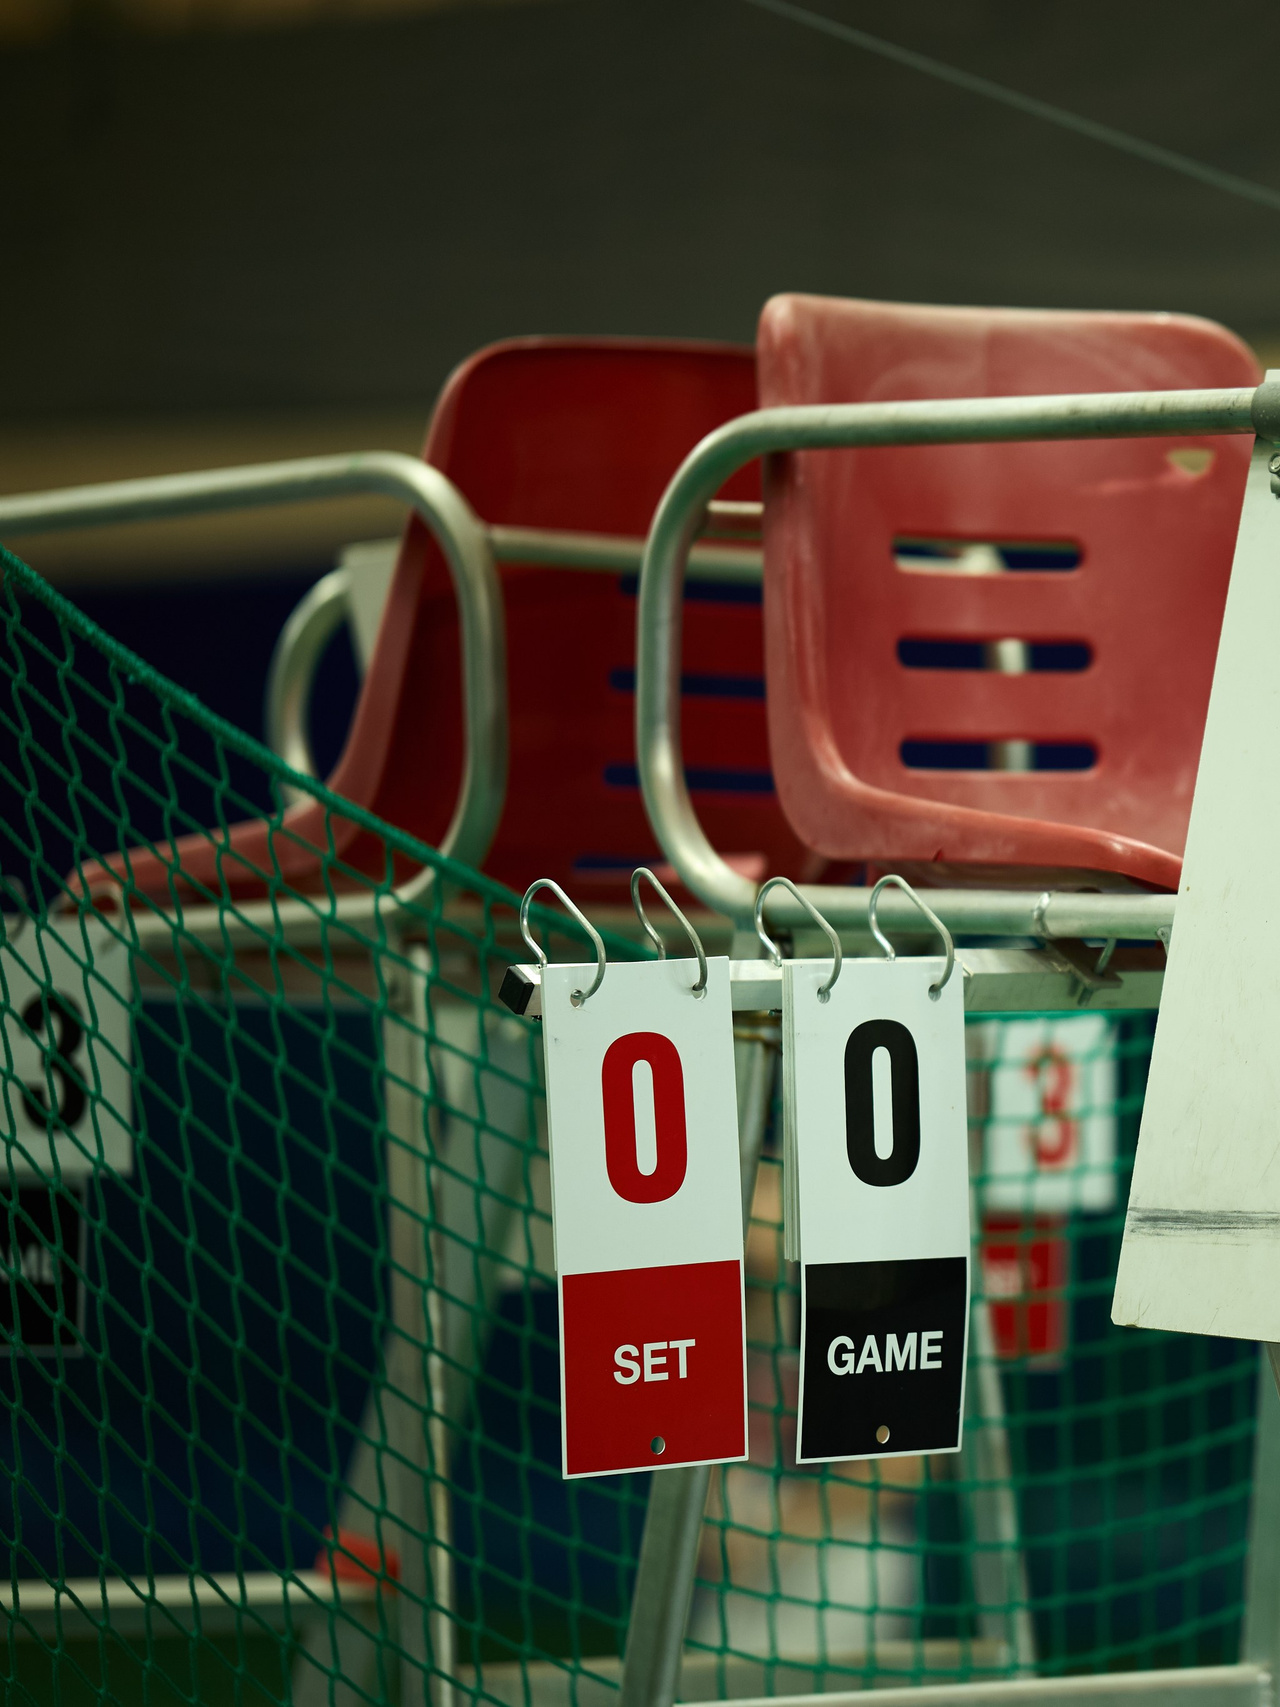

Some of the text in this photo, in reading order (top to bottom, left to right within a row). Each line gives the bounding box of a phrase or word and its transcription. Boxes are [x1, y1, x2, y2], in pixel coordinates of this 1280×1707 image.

[20, 989, 88, 1134] 3
[601, 1031, 688, 1204] 0
[844, 1018, 921, 1187] 0
[613, 1338, 696, 1385] SET
[827, 1330, 944, 1376] GAME
